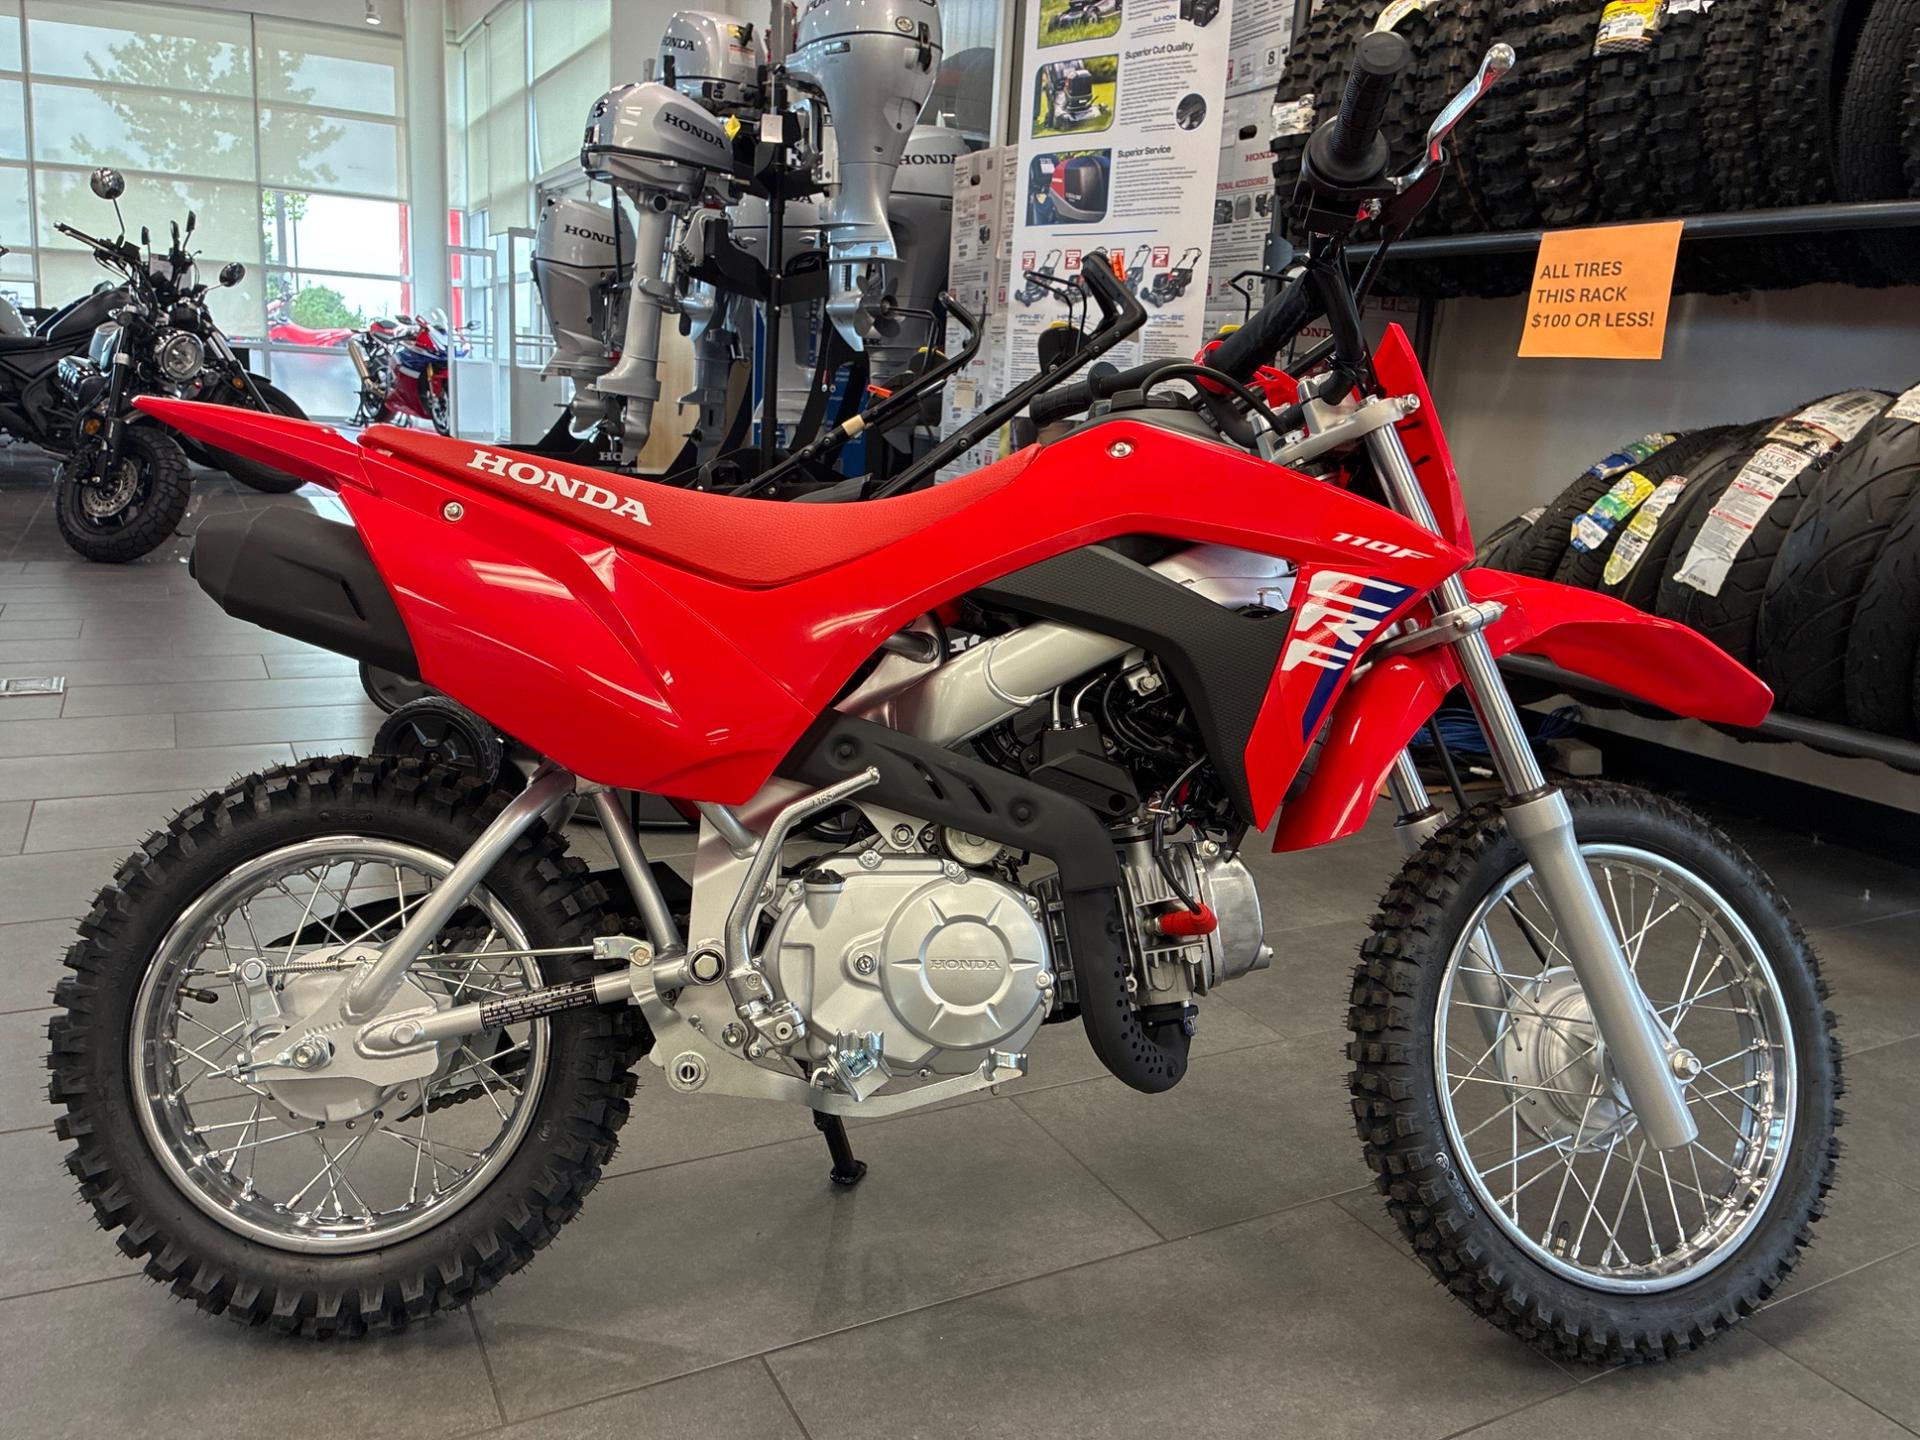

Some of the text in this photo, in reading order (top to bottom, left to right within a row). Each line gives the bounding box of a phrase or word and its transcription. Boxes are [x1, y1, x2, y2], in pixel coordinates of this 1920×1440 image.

[1125, 42, 1194, 60] Superior Cut Quality
[1267, 50, 1276, 65] 8
[663, 112, 726, 150] HONDA
[1117, 145, 1172, 159] Superior Service
[563, 224, 616, 246] HOND
[1154, 254, 1167, 265] 2
[1540, 260, 1624, 280] ALL TIRES
[1246, 278, 1255, 291] 8
[1536, 286, 1628, 304] THIS RACK
[1530, 311, 1655, 330] $100 OR LESS!
[466, 448, 652, 527] HONDA
[1331, 531, 1436, 560] 110F
[1280, 569, 1406, 672] CRF
[929, 958, 1001, 971] HONDA
